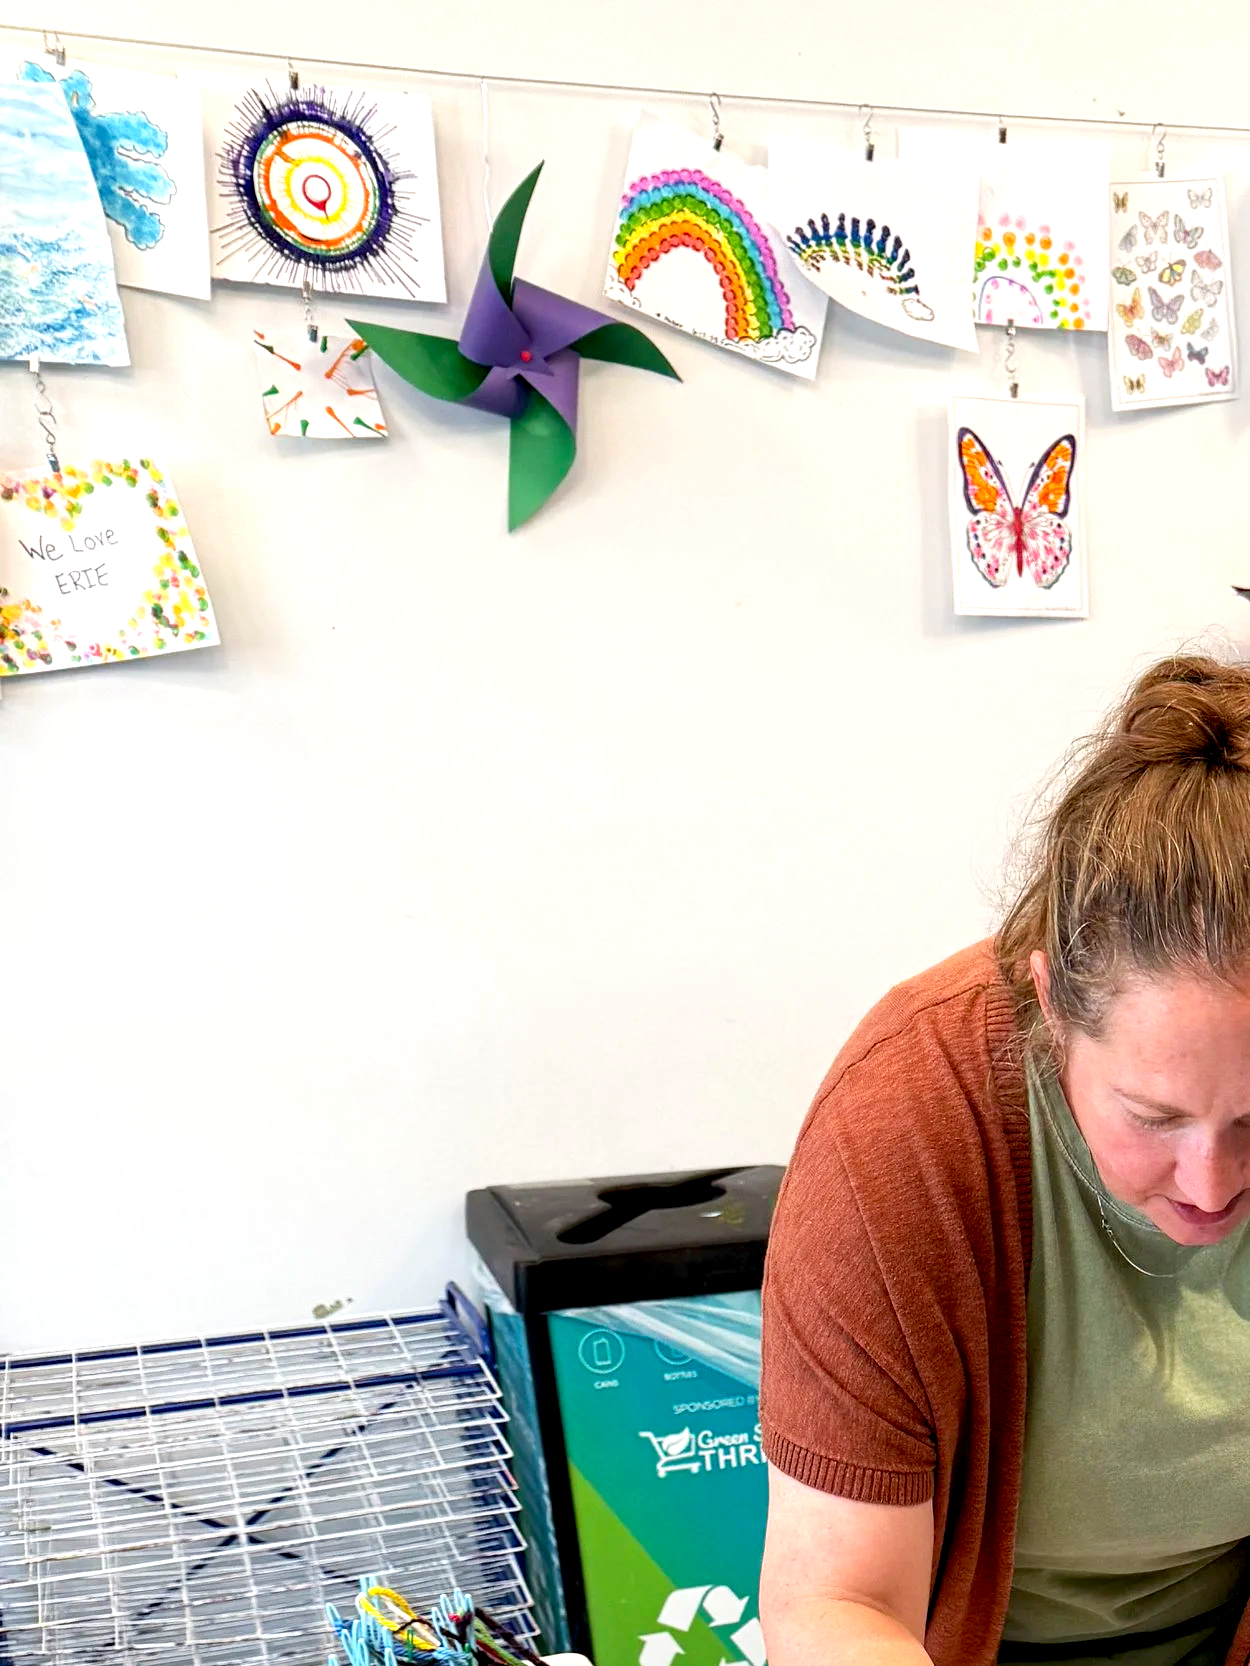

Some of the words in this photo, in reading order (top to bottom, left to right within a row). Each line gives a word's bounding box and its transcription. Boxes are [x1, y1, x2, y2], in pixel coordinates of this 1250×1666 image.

[18, 535, 64, 561] We
[68, 529, 118, 552] Love
[55, 563, 109, 595] ERIE
[672, 1396, 745, 1415] SPONSORED
[697, 1430, 749, 1449] Green
